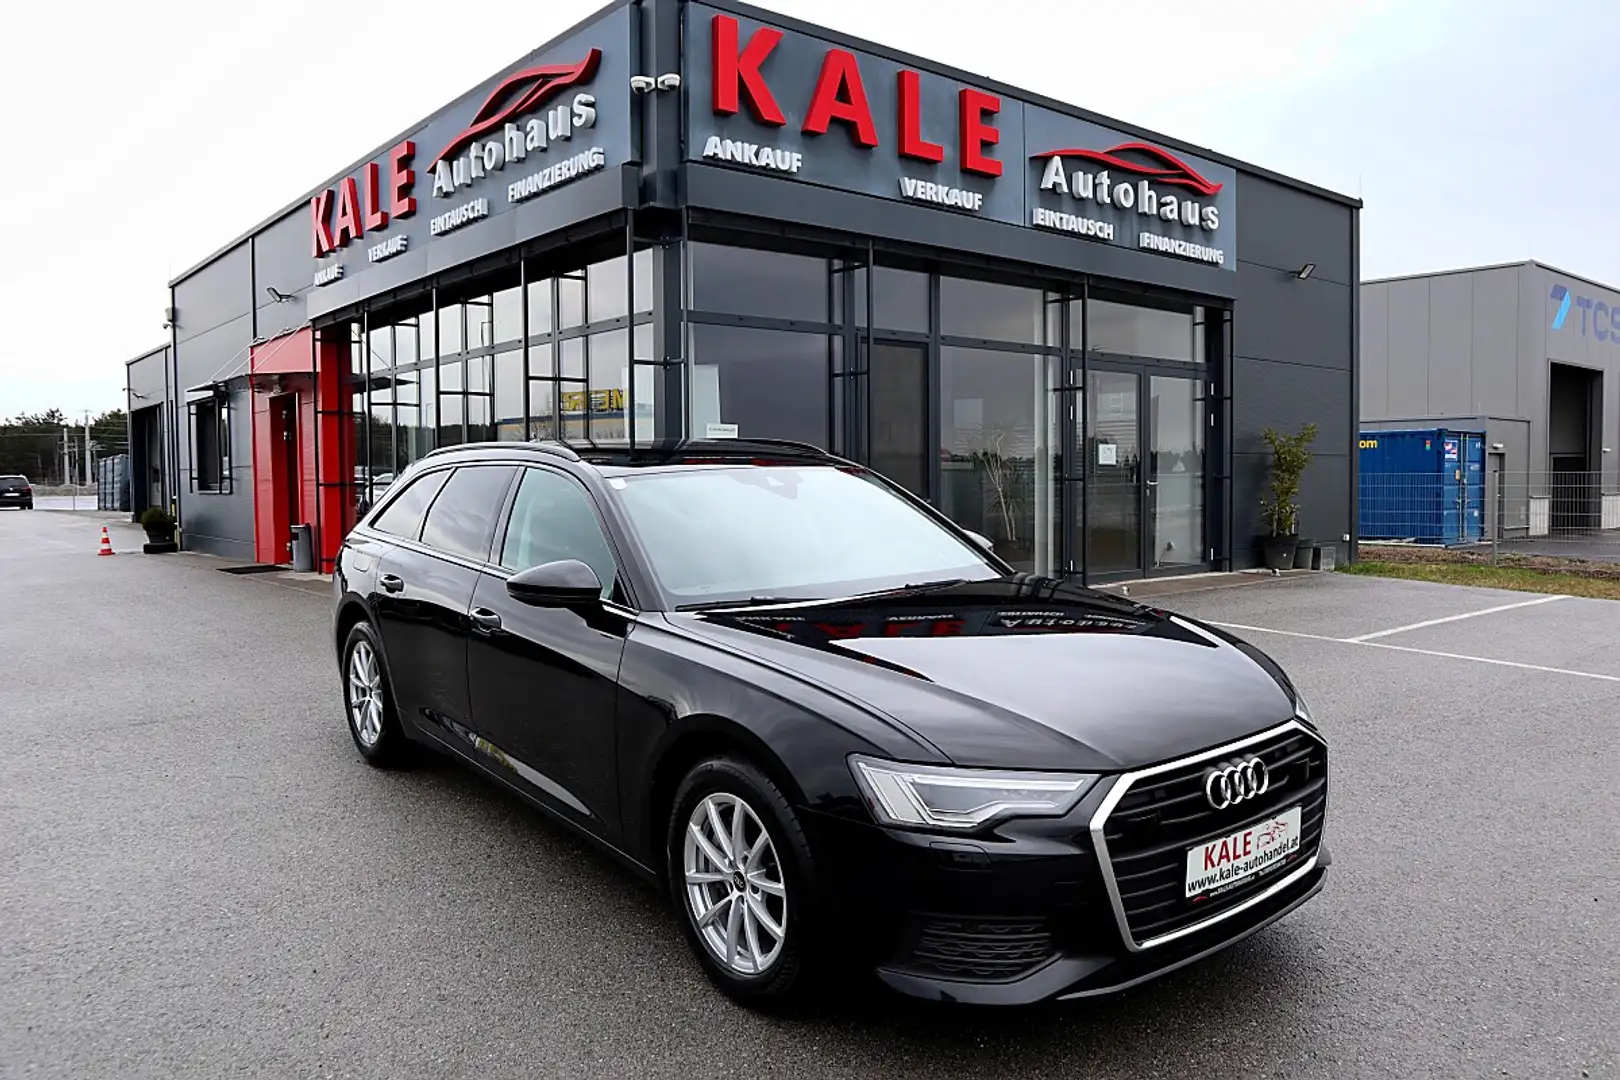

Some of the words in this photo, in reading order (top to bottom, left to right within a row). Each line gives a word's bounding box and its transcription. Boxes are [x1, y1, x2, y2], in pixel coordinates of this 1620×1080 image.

[712, 15, 1002, 177] KALE
[430, 197, 489, 236] EINTAUSCH
[508, 146, 605, 203] FINANZIERUNG
[433, 93, 596, 197] Autohaus
[1040, 155, 1219, 230] Autohaus
[311, 141, 416, 258] KALE
[702, 136, 802, 173] ANKAUF
[899, 177, 983, 211] VERKAUF
[1033, 207, 1114, 240] EINTAUSCH
[1140, 232, 1225, 264] FINANZIERUNG
[1188, 836, 1299, 893] www.kale-autohandel.at
[1204, 831, 1253, 871] KALE
